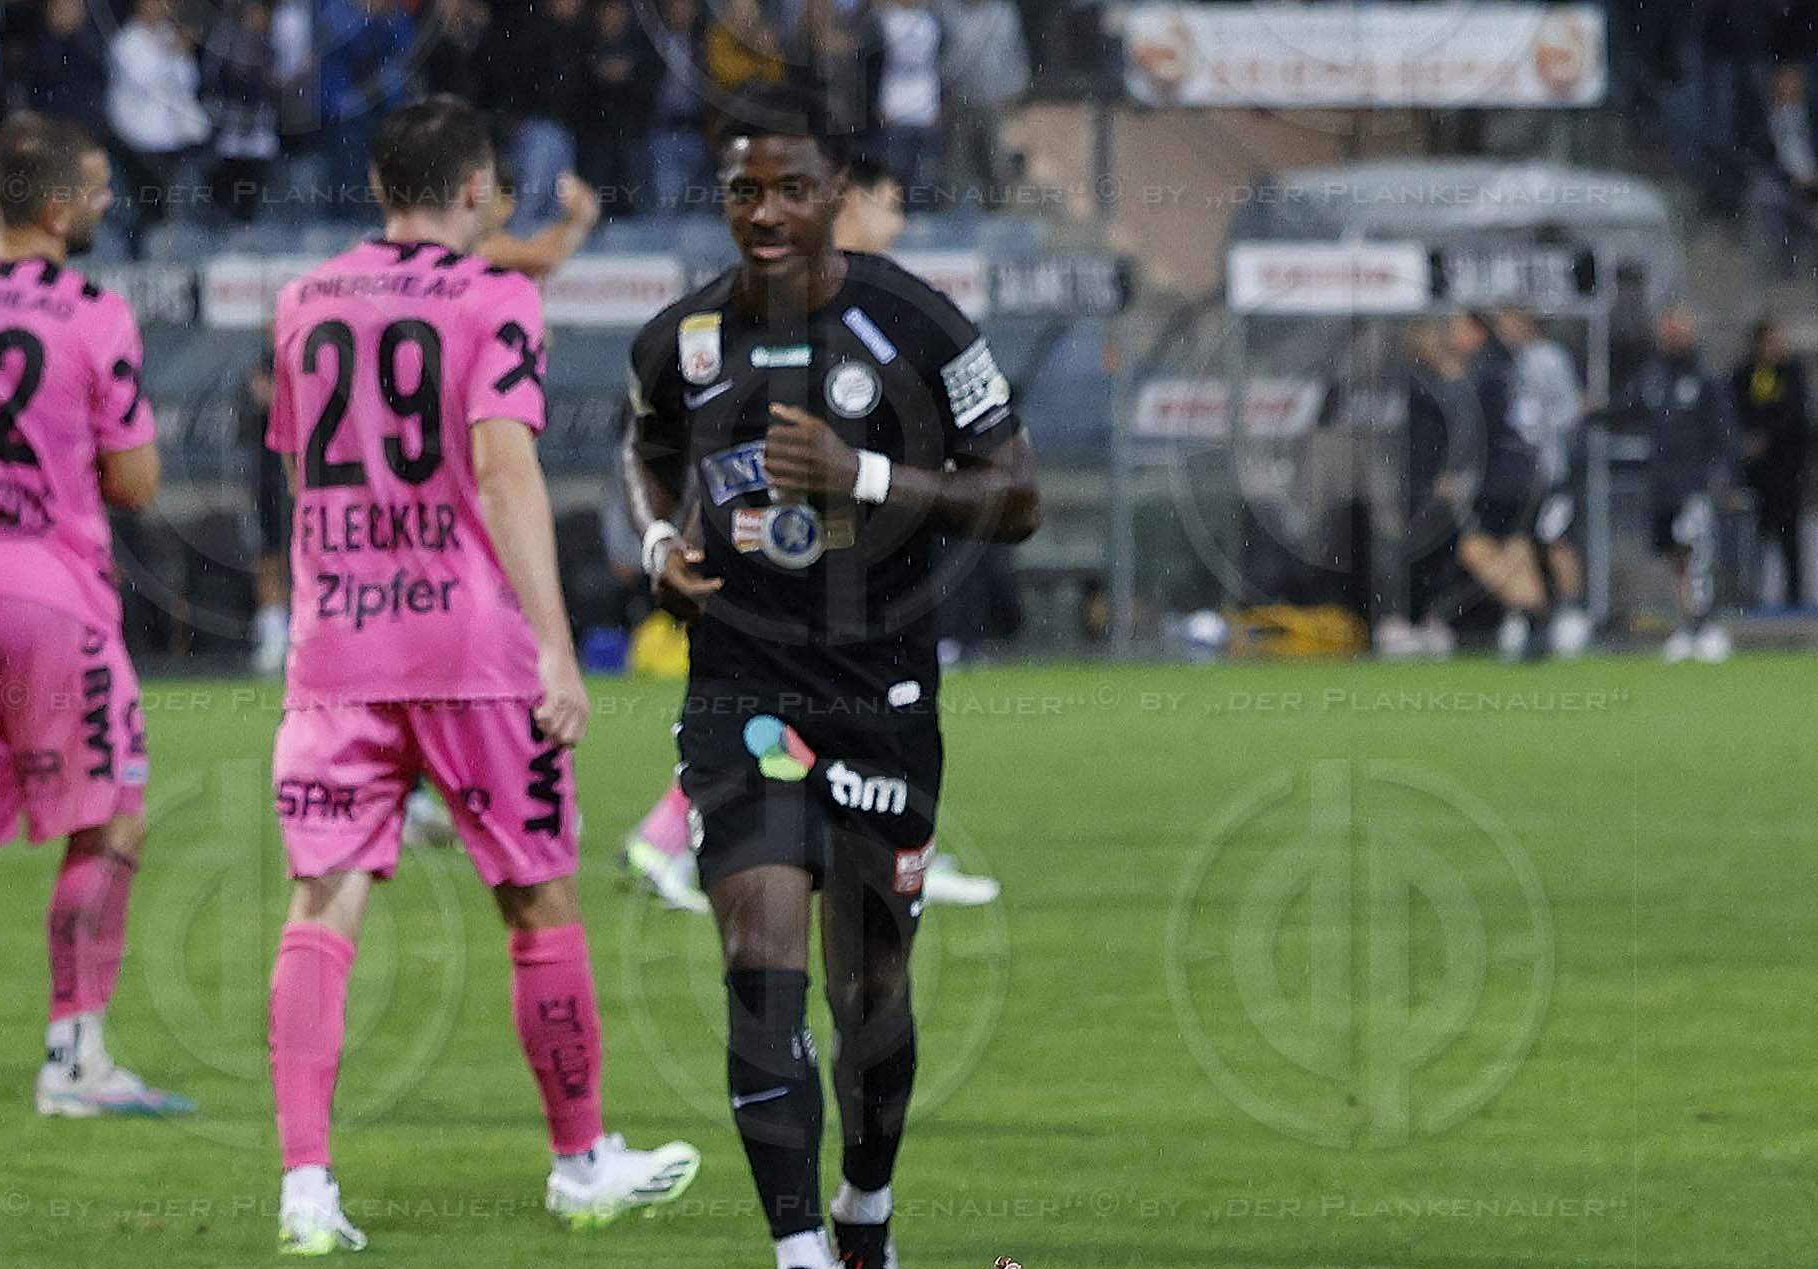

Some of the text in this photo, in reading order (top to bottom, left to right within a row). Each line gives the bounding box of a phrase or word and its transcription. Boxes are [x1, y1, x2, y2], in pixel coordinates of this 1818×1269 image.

[302, 318, 445, 489] 29
[301, 503, 461, 553] FLECKER
[316, 568, 461, 631] Zipfer
